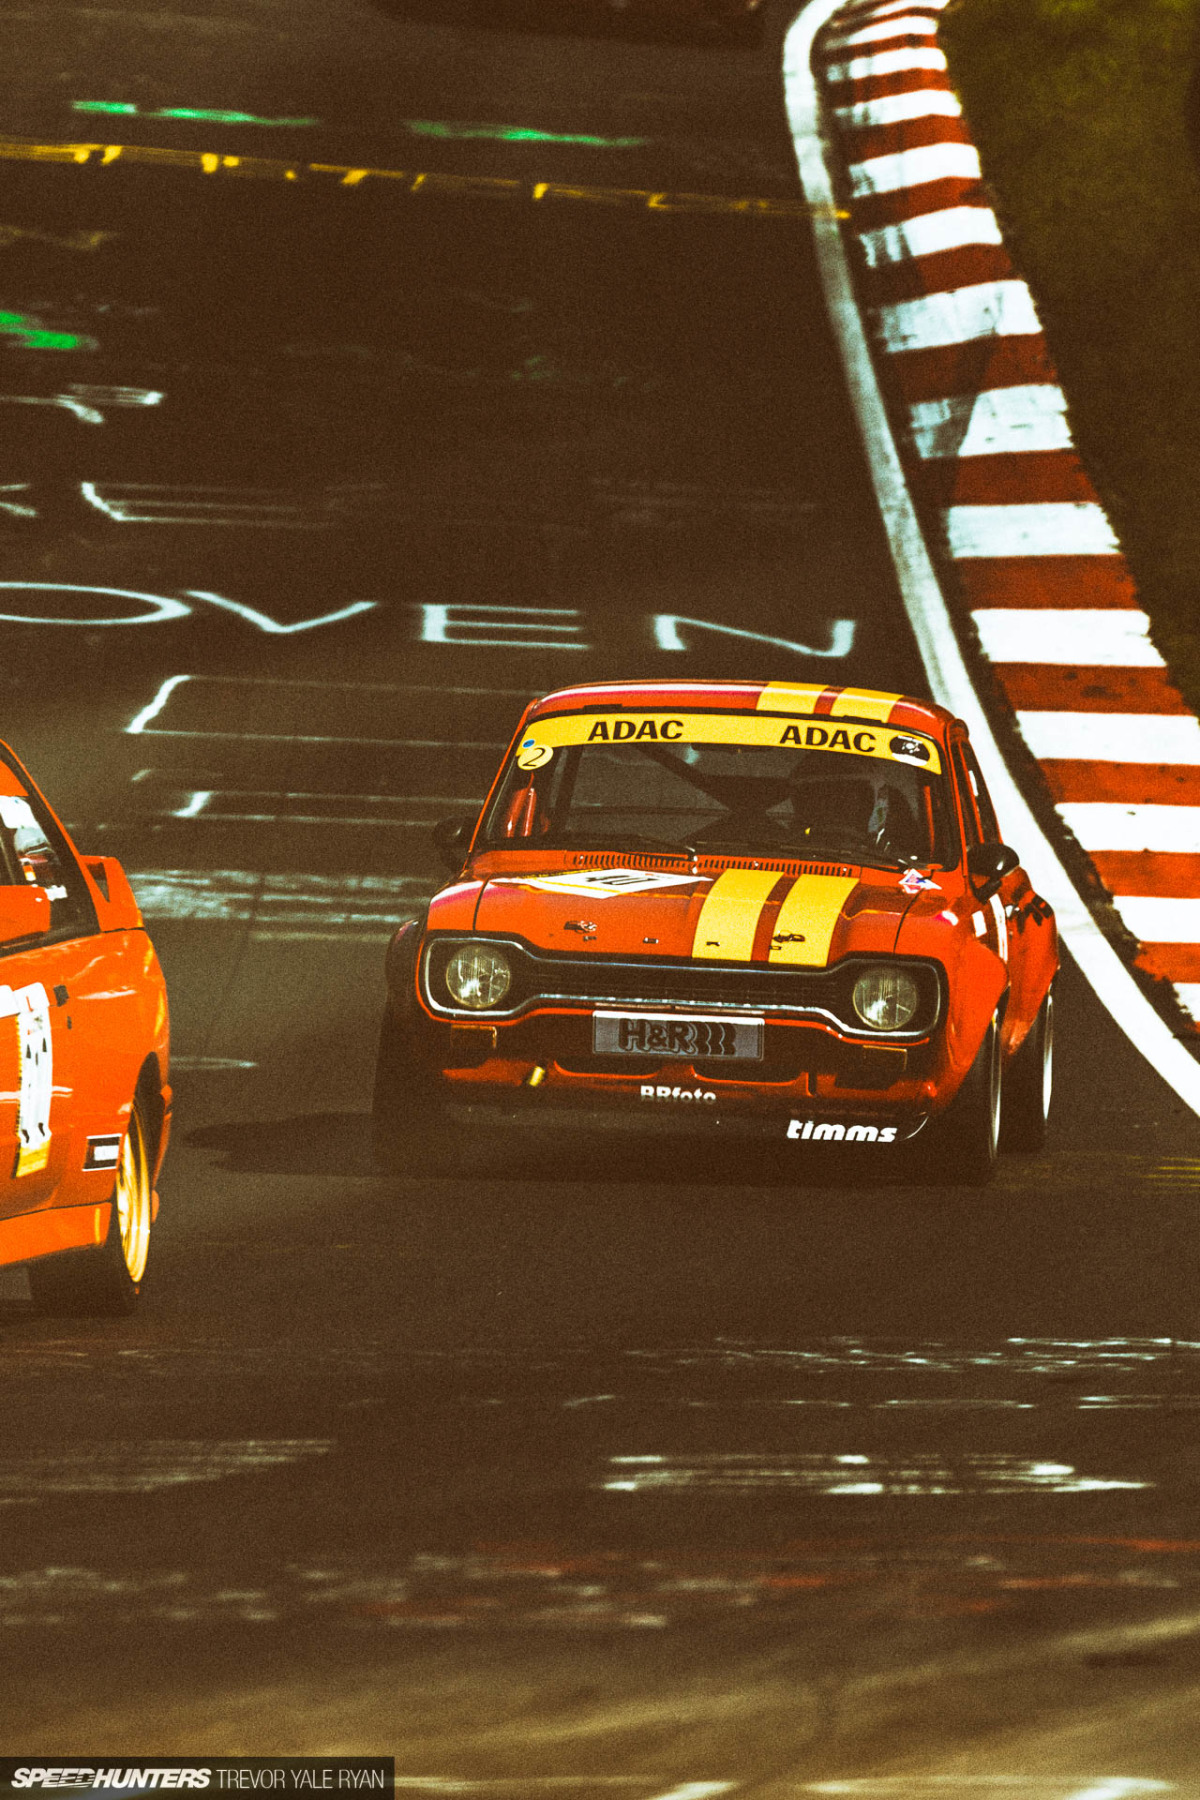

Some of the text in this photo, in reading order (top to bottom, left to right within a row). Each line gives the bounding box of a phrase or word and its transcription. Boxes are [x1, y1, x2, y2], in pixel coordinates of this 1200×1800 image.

[587, 720, 684, 742] ADAC
[779, 725, 876, 753] ADAC
[521, 747, 546, 767] 2
[786, 1118, 898, 1143] timms
